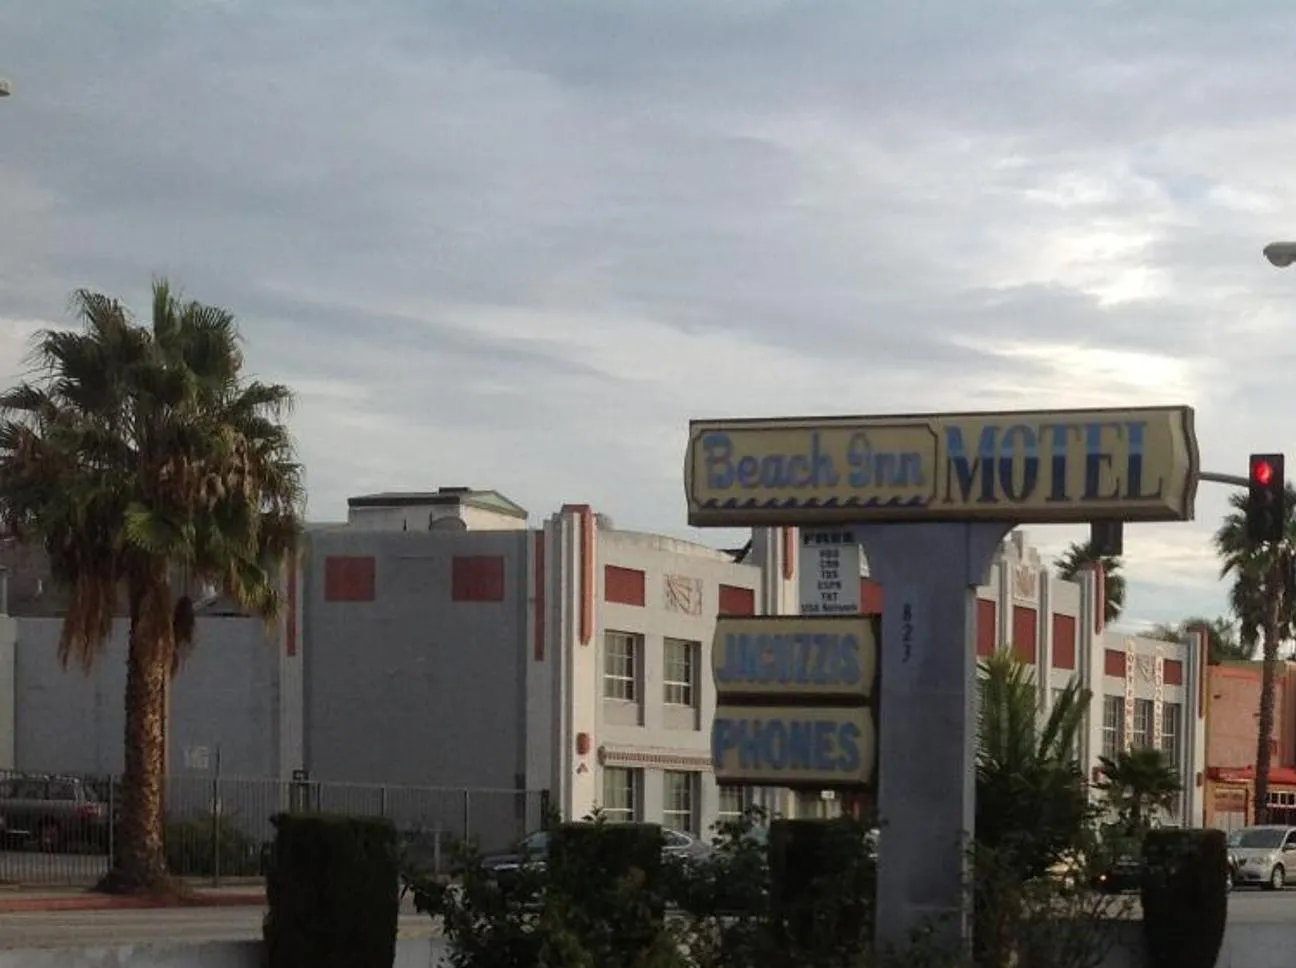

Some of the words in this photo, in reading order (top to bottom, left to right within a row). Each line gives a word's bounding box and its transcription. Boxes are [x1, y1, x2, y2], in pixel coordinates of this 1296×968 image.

[703, 432, 840, 491] Beach
[846, 432, 927, 488] Inn
[942, 419, 1164, 505] MOTEL
[713, 717, 861, 773] PHONES
